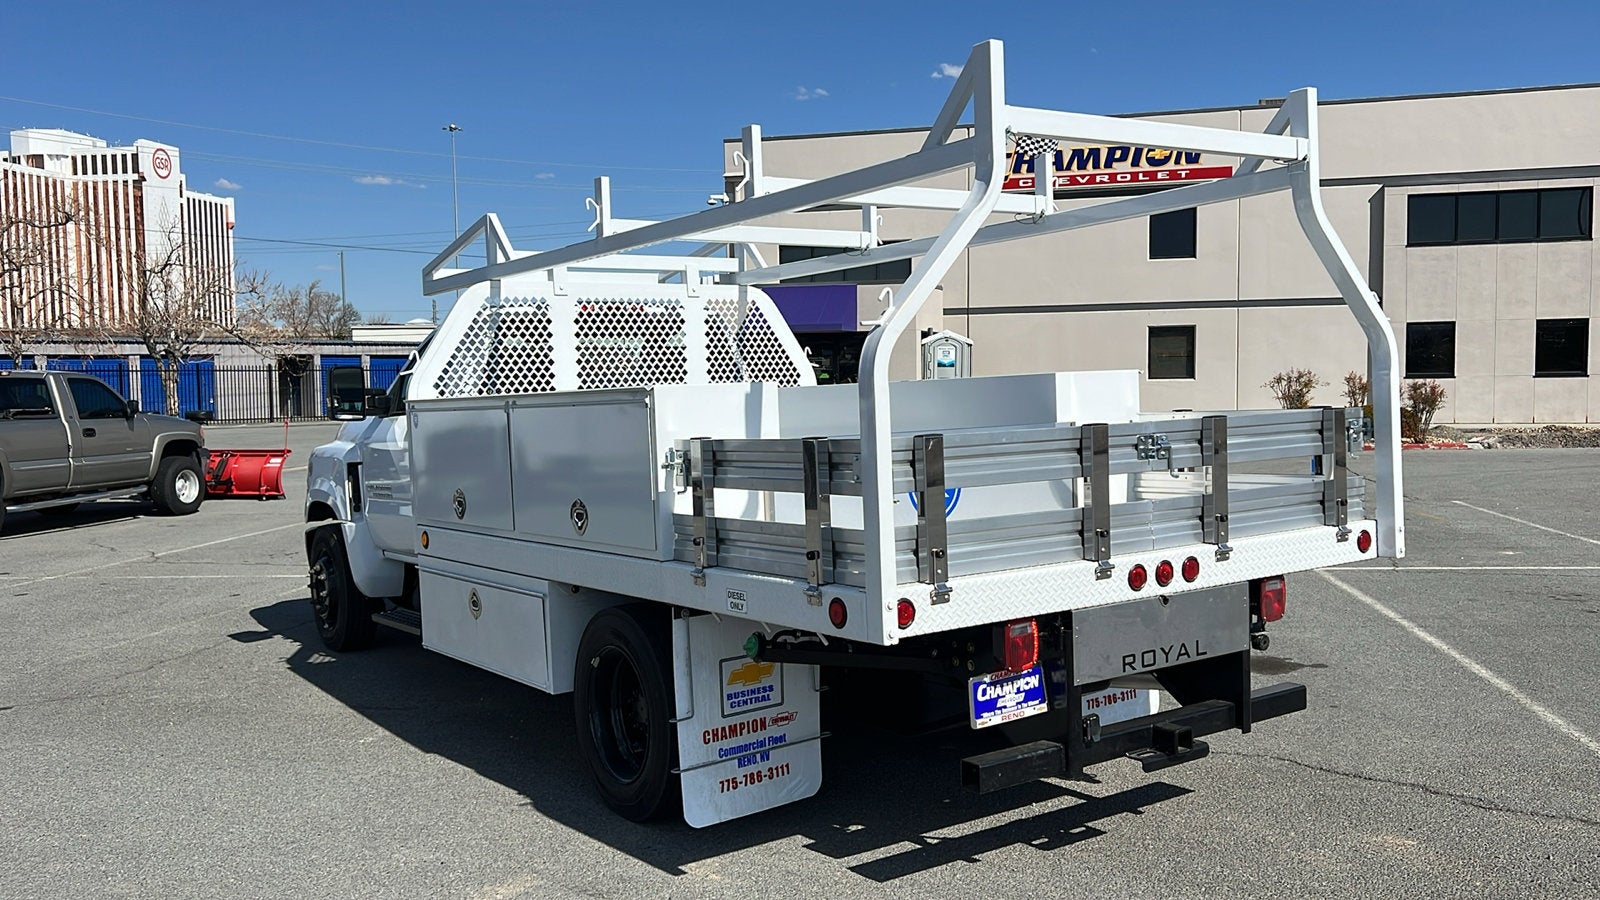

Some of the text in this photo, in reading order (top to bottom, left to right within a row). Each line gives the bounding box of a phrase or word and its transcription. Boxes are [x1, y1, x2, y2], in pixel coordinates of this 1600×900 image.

[155, 156, 169, 171] GSR
[1004, 145, 1202, 182] HAMPION
[1019, 169, 1191, 188] CEVROLET
[728, 590, 746, 602] DIESEL
[730, 601, 744, 611] ONLY
[1122, 640, 1208, 673] ROYAL
[726, 684, 774, 701] BUSINESS
[977, 674, 1039, 701] CHAMPION
[730, 693, 771, 709] CENTRAL
[1086, 688, 1137, 710] 775-786-3111
[1001, 710, 1025, 721] RENO
[702, 717, 767, 745] CHAMPION
[718, 732, 787, 759] Commercial Fleet
[760, 750, 771, 764] NV
[719, 762, 790, 794] 775-786-3111
